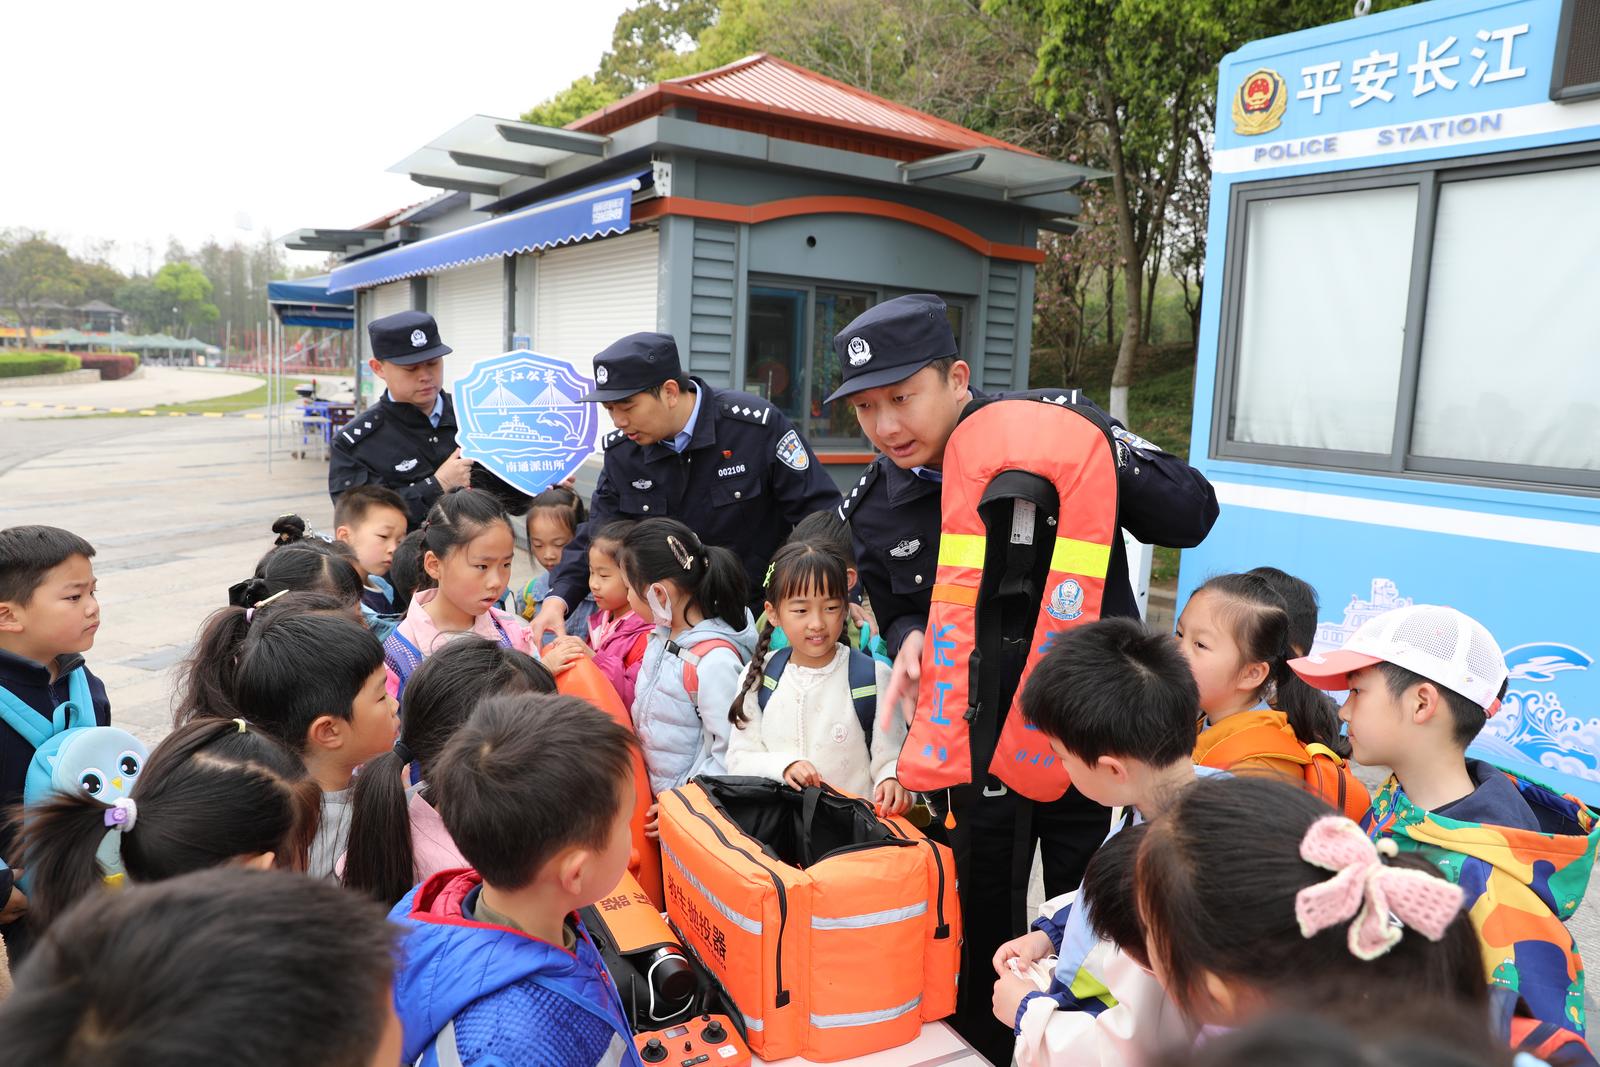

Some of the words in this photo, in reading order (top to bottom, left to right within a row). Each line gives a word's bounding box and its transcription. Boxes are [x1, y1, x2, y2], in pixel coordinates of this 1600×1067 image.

[1297, 23, 1530, 115] 平安长江
[1254, 137, 1338, 162] POLICE
[1377, 113, 1504, 147] STATION
[492, 369, 558, 384] 长江公安
[505, 460, 566, 473] 南通派出所
